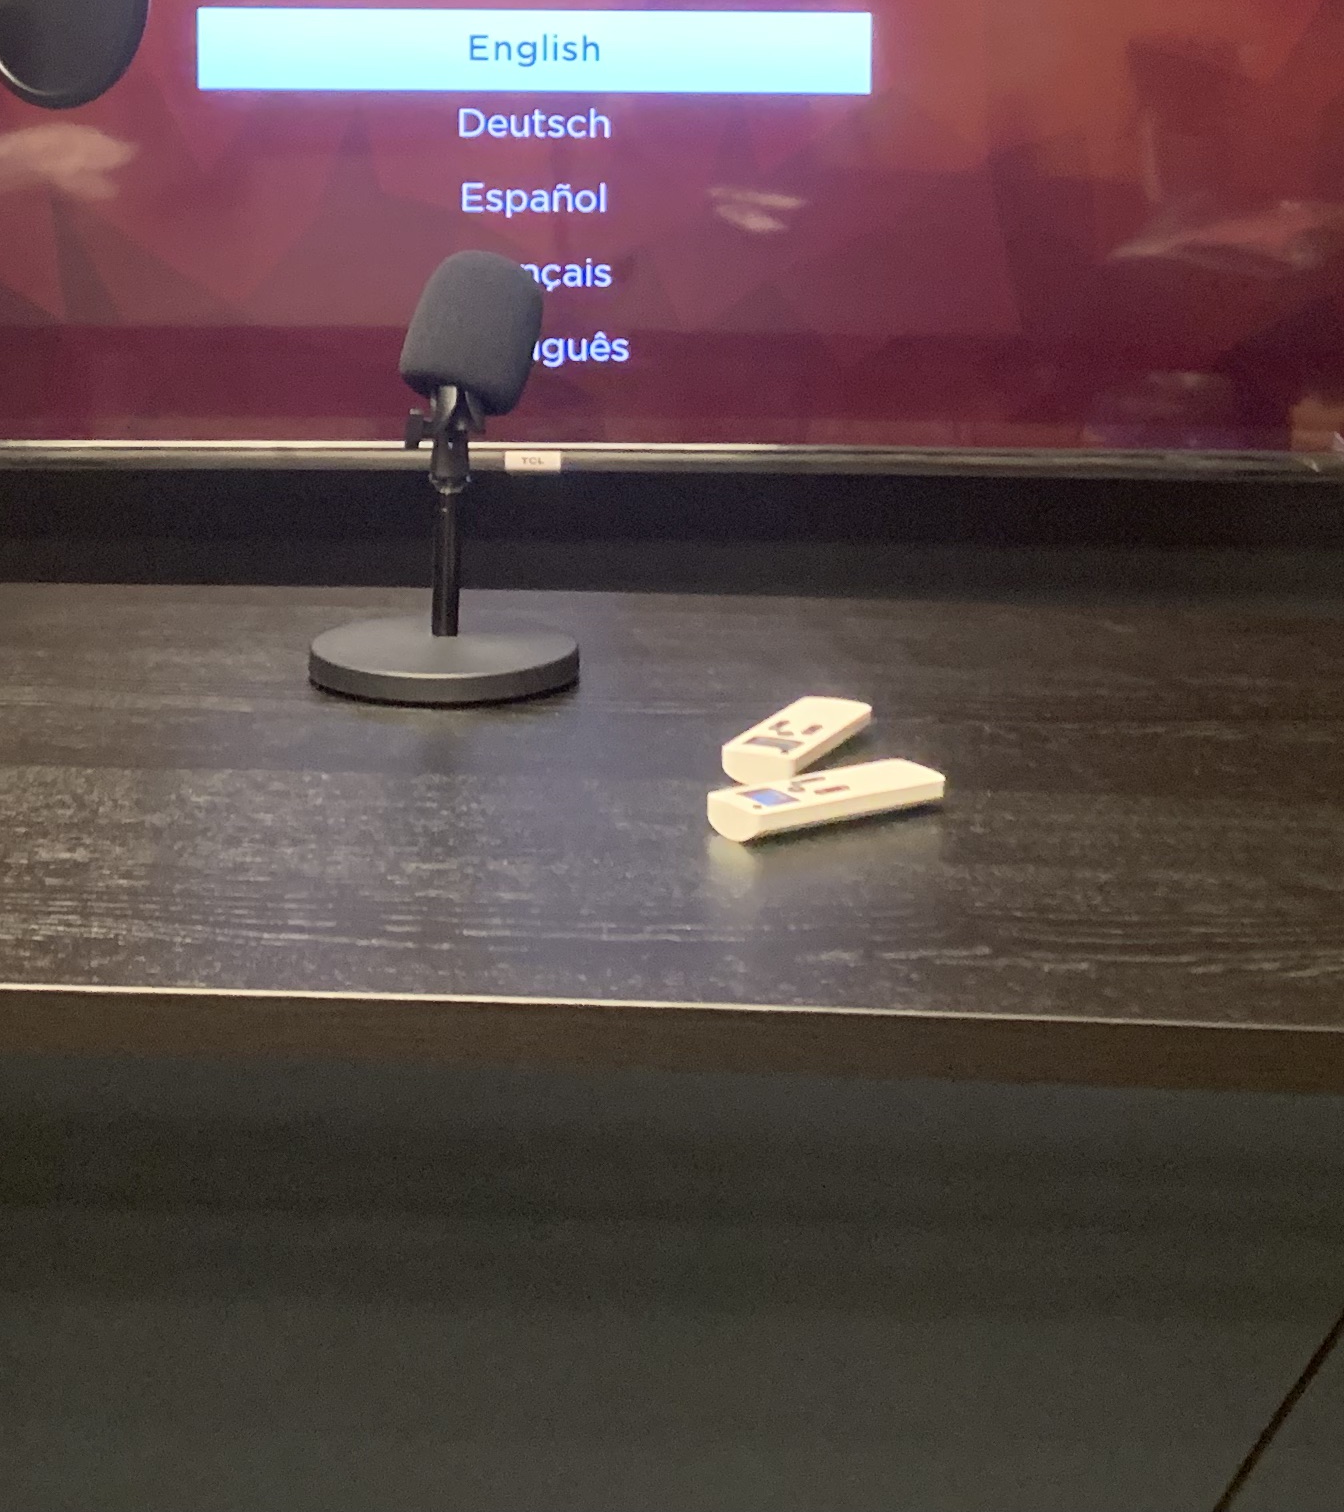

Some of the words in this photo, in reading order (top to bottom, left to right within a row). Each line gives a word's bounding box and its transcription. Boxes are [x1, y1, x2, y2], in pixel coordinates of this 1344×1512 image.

[469, 33, 601, 68] English
[457, 106, 612, 139] Deutsch
[461, 181, 607, 219] Español
[521, 456, 545, 465] TCL
